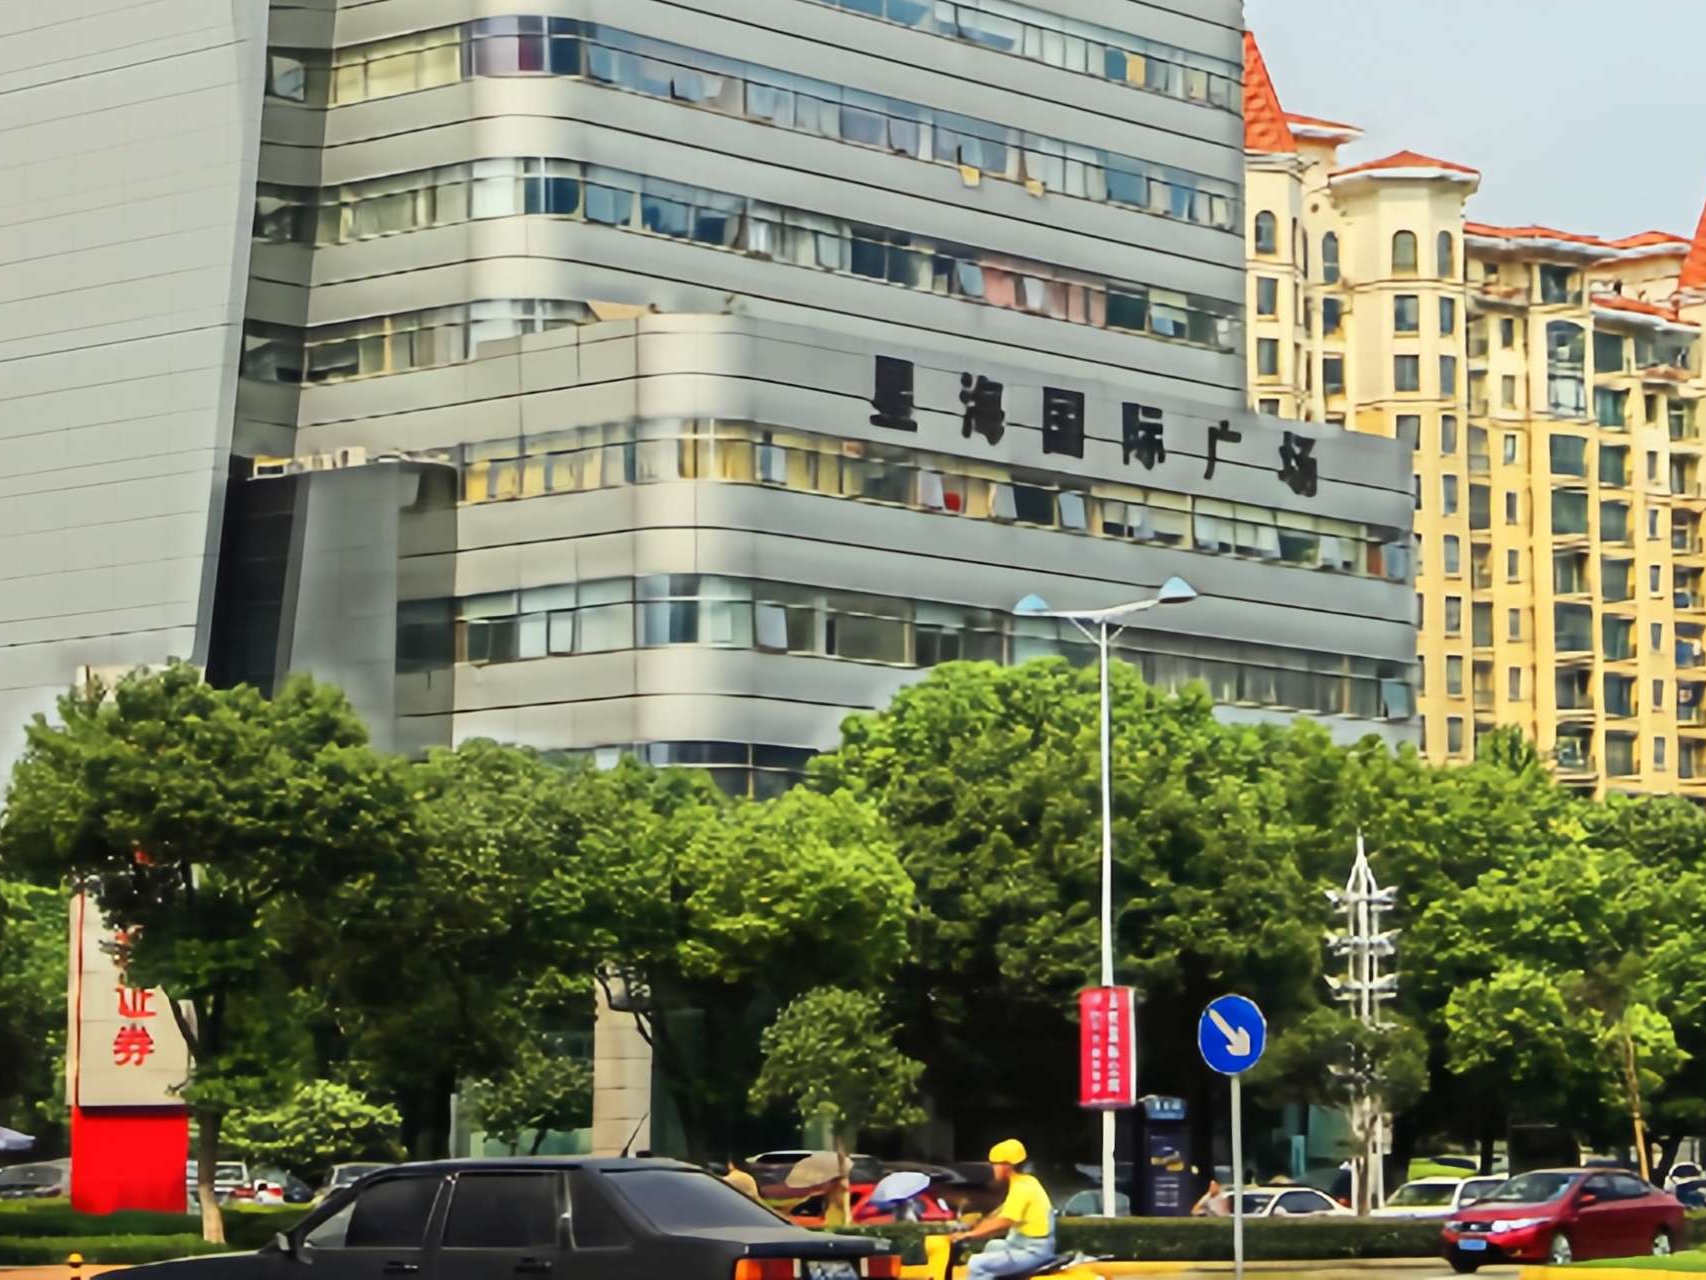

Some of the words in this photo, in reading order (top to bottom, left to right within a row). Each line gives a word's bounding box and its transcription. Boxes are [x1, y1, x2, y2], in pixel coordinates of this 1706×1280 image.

[869, 354, 1319, 498] 星海国际广场
